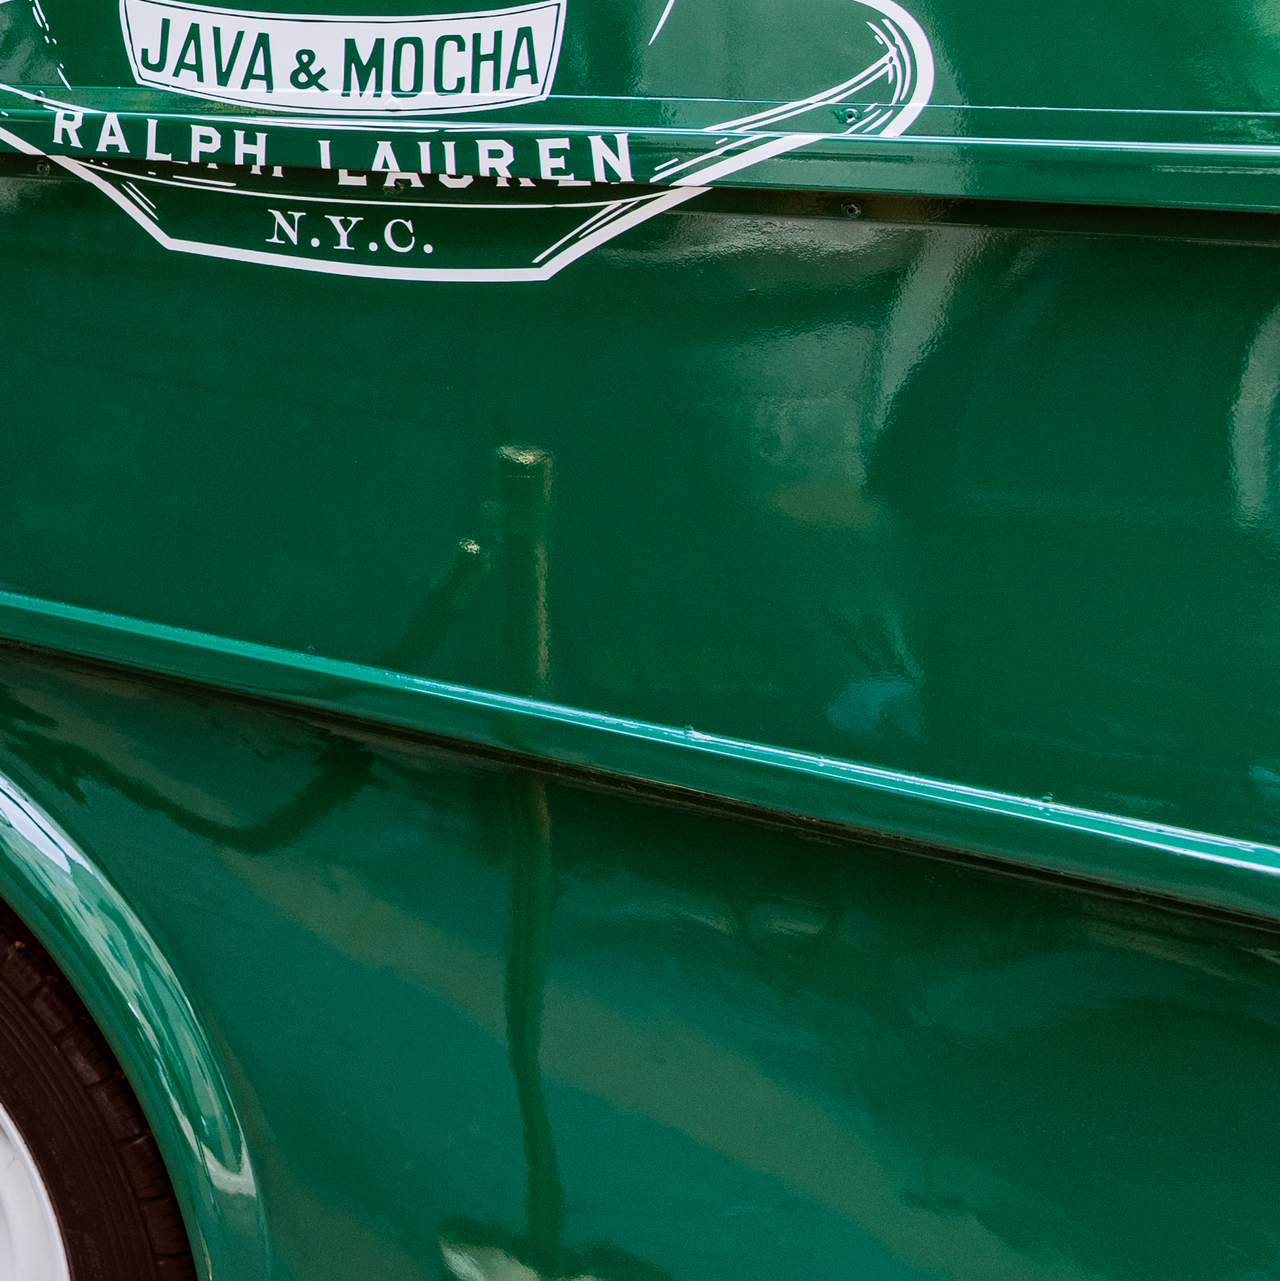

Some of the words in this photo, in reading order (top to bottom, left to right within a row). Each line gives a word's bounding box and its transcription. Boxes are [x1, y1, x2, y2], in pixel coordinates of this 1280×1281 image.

[140, 17, 274, 95] JAVA
[289, 47, 330, 93] &
[340, 25, 540, 99] MOCHA
[52, 109, 285, 179] RALPH
[316, 131, 645, 190] LAUREN
[265, 208, 435, 255] N.Y.C.
